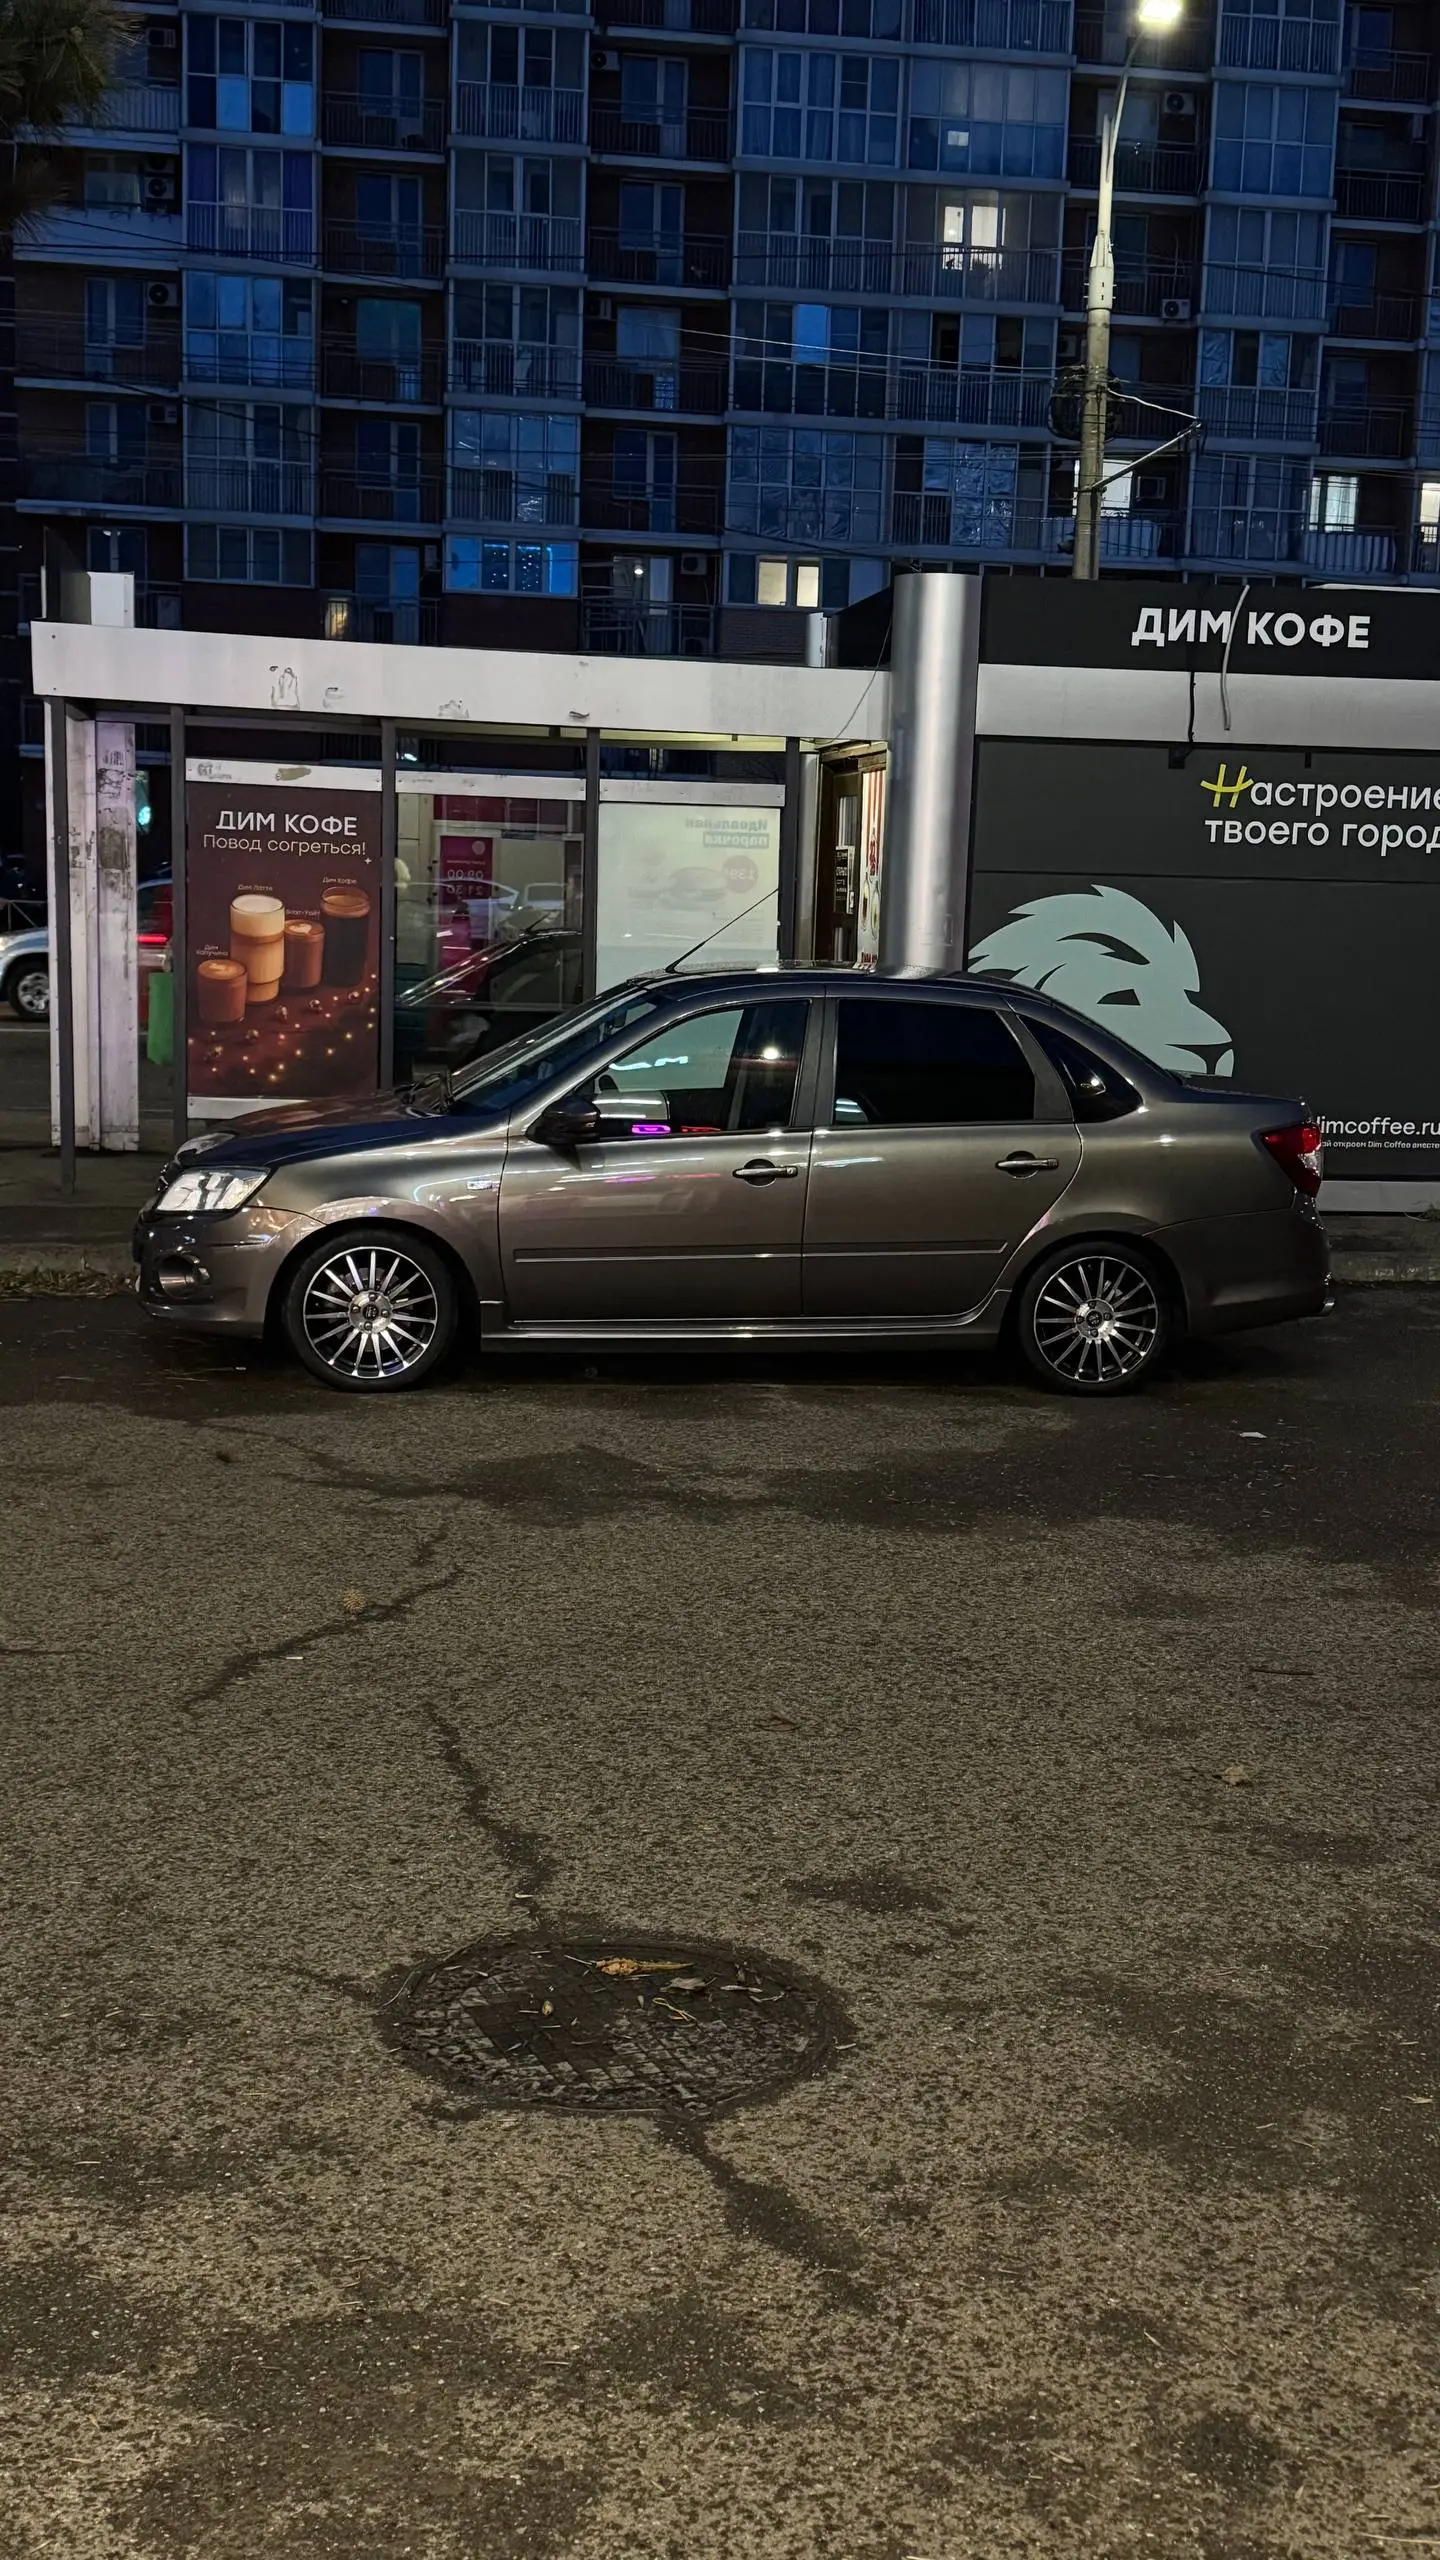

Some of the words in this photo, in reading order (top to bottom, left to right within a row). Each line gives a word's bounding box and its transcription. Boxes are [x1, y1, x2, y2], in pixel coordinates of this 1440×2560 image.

[1131, 607, 1232, 647] ДИМ
[1247, 611, 1371, 649] КОФЕ
[215, 810, 275, 832] ДИМ
[285, 813, 358, 836] КОФЕ
[1204, 819, 1330, 847] твоего
[203, 835, 262, 853] Повод
[267, 839, 367, 857] согреться!
